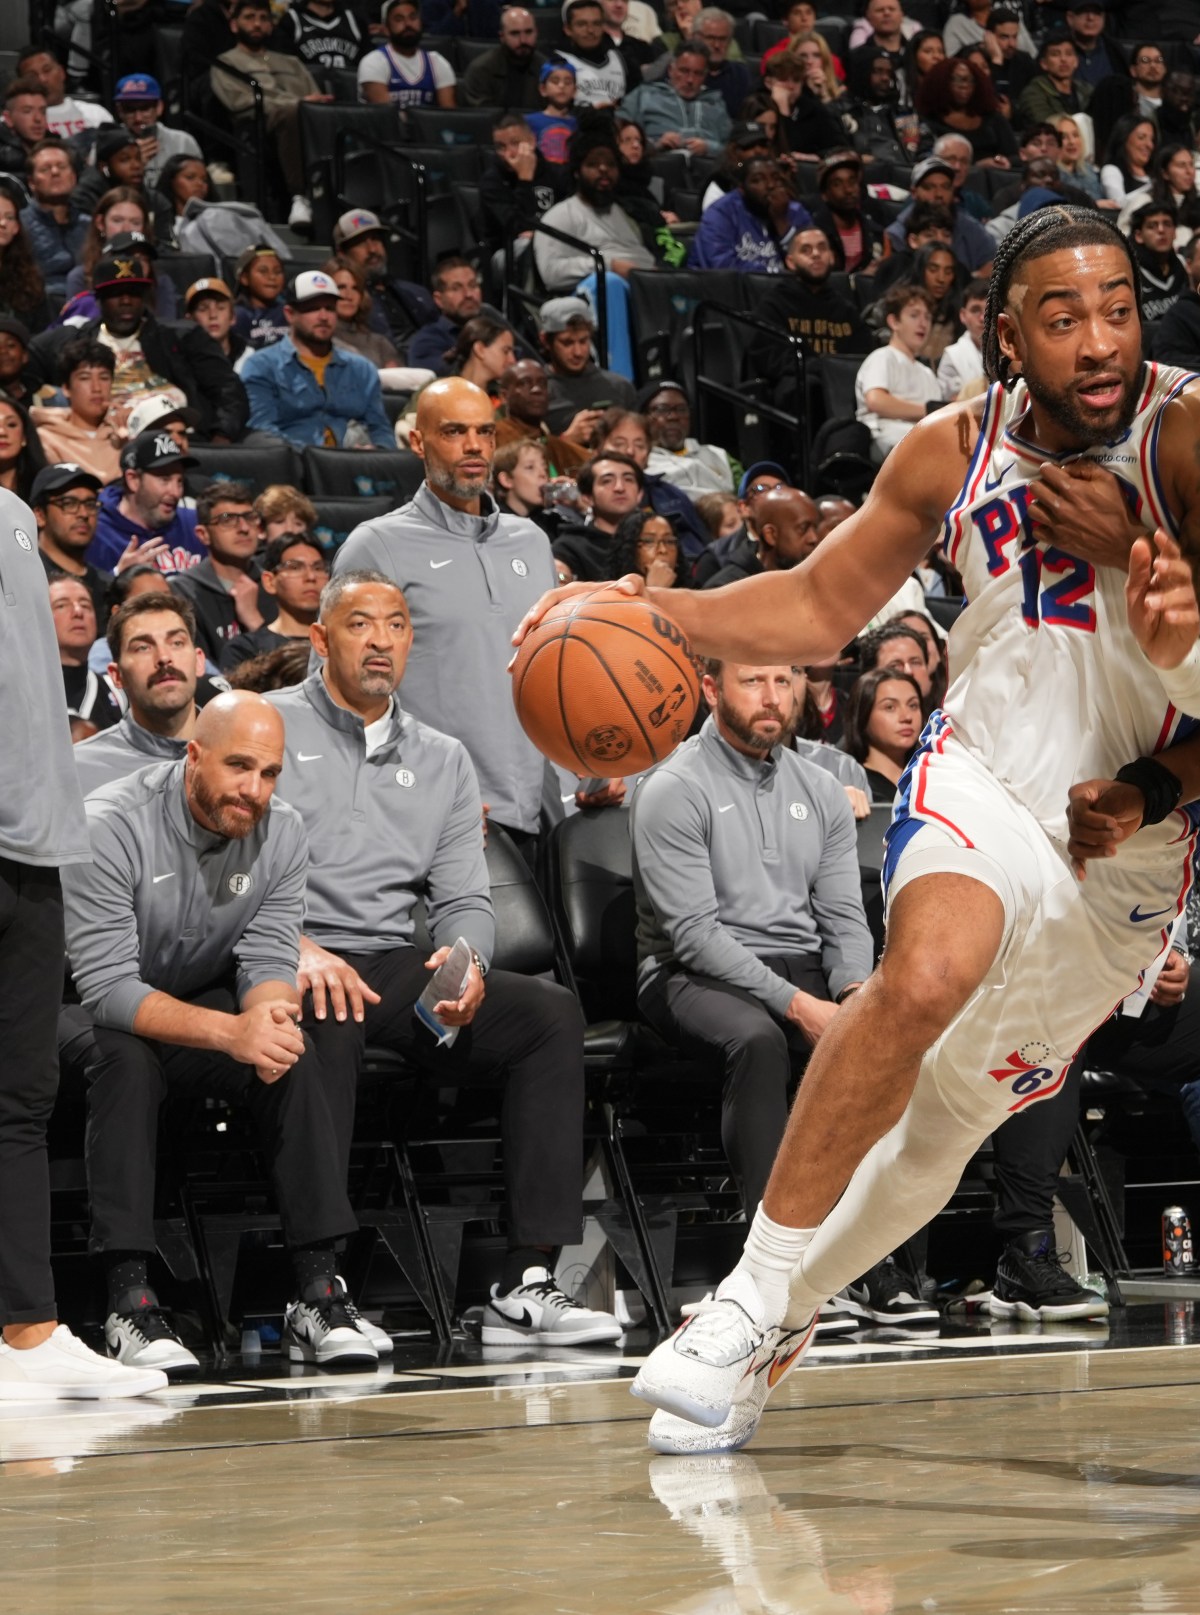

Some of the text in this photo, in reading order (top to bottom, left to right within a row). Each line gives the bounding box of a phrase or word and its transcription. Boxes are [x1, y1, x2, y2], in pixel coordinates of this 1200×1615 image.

[300, 37, 358, 60] BROOKLYN
[1019, 548, 1097, 635] 12
[987, 1050, 1054, 1096] 76
